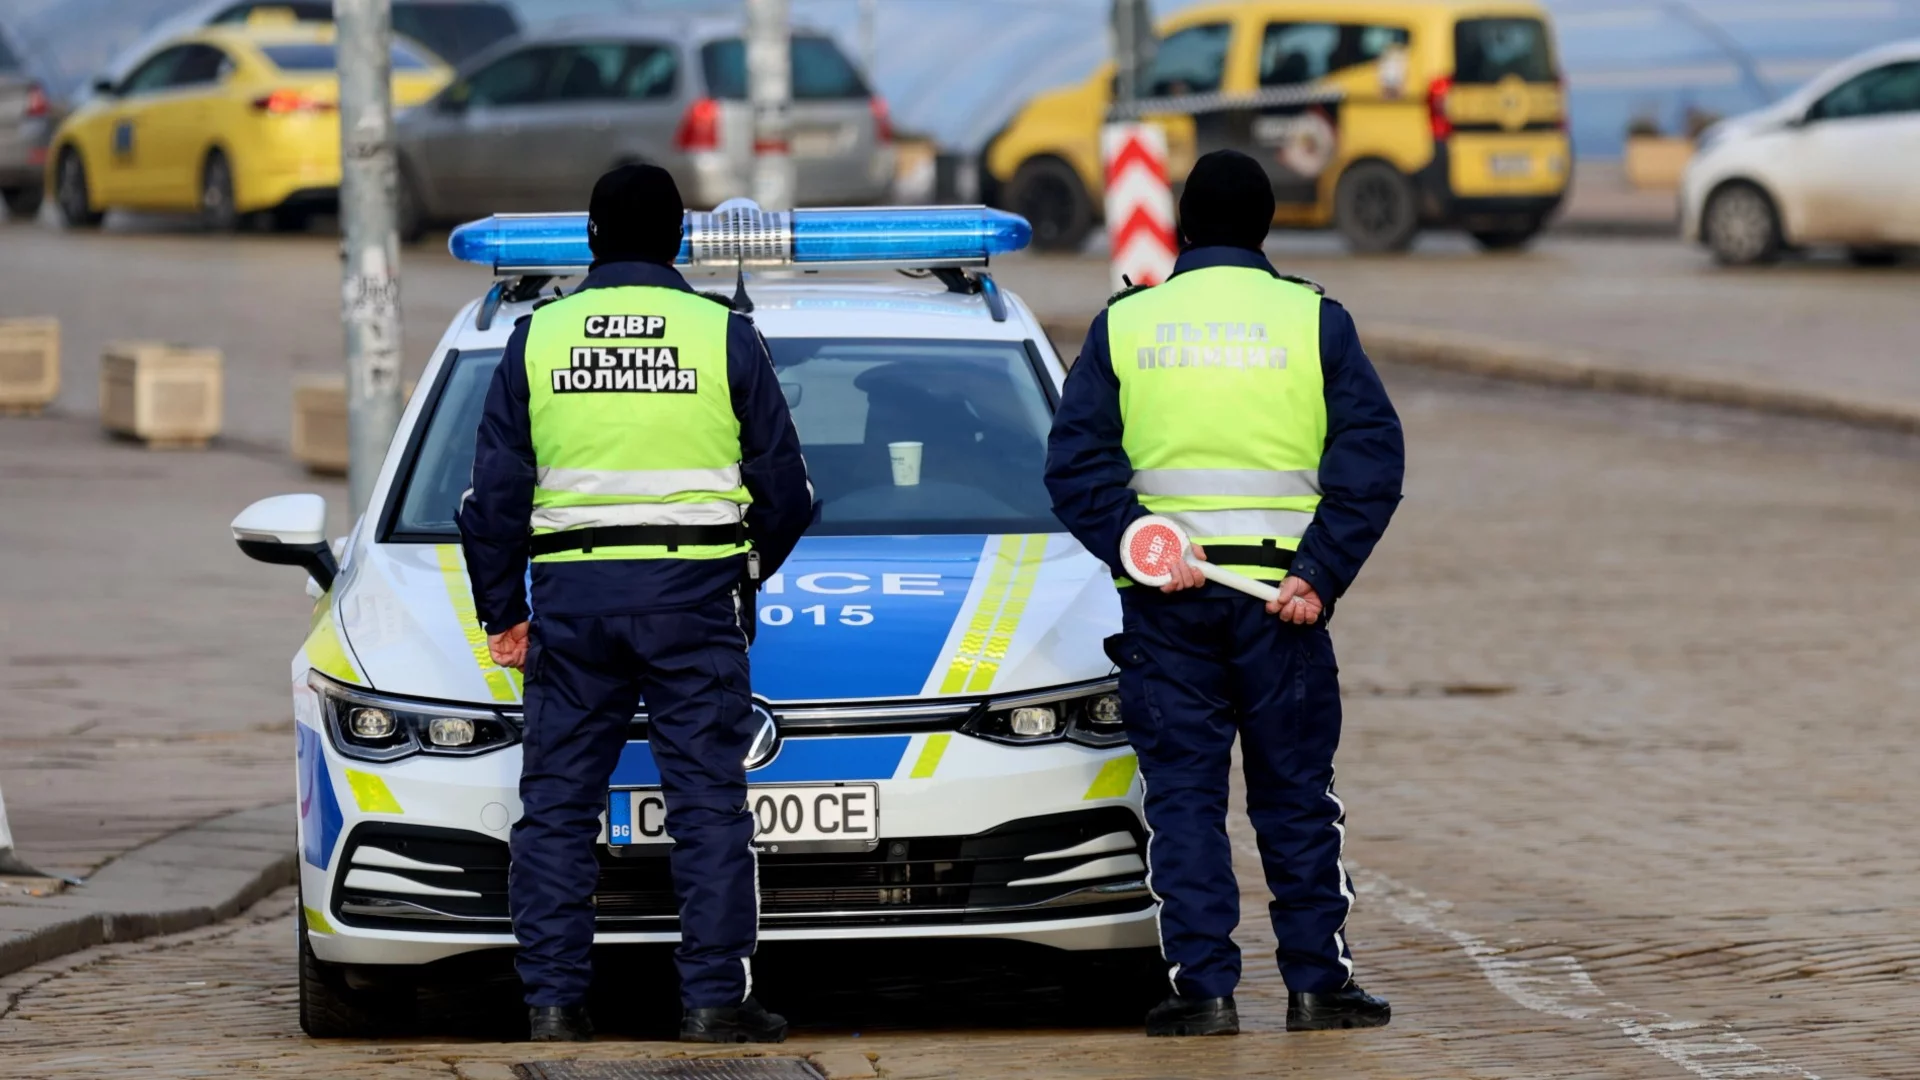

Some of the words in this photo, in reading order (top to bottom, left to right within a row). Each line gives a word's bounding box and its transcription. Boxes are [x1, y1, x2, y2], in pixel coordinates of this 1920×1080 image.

[586, 316, 664, 338] СДВР
[1156, 322, 1268, 343] ПЪТНА
[572, 348, 676, 368] ПЪТНА
[1137, 346, 1288, 371] ПОЛИЦИЯ
[553, 370, 696, 391] ПОЛИЦИЯ
[765, 572, 945, 596] ICE
[759, 604, 874, 626] 015
[639, 797, 664, 837] C
[754, 794, 803, 835] 00
[814, 793, 868, 833] CE
[612, 825, 630, 837] BG
